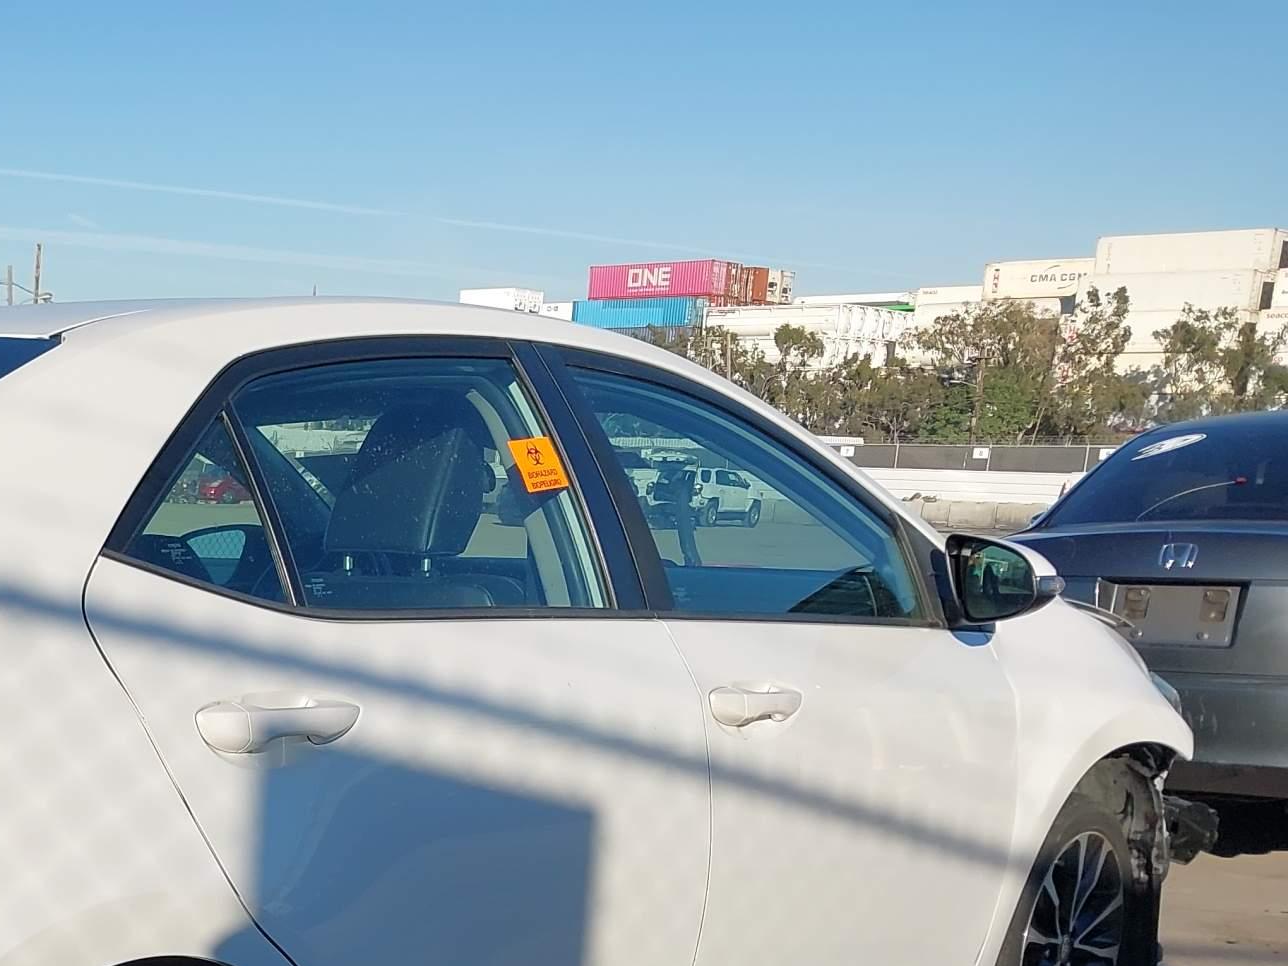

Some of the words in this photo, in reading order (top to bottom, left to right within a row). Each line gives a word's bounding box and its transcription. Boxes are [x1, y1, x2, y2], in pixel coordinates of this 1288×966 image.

[627, 267, 672, 287] ONE
[1030, 274, 1057, 283] CMA
[528, 468, 558, 479] BIOHAZARD
